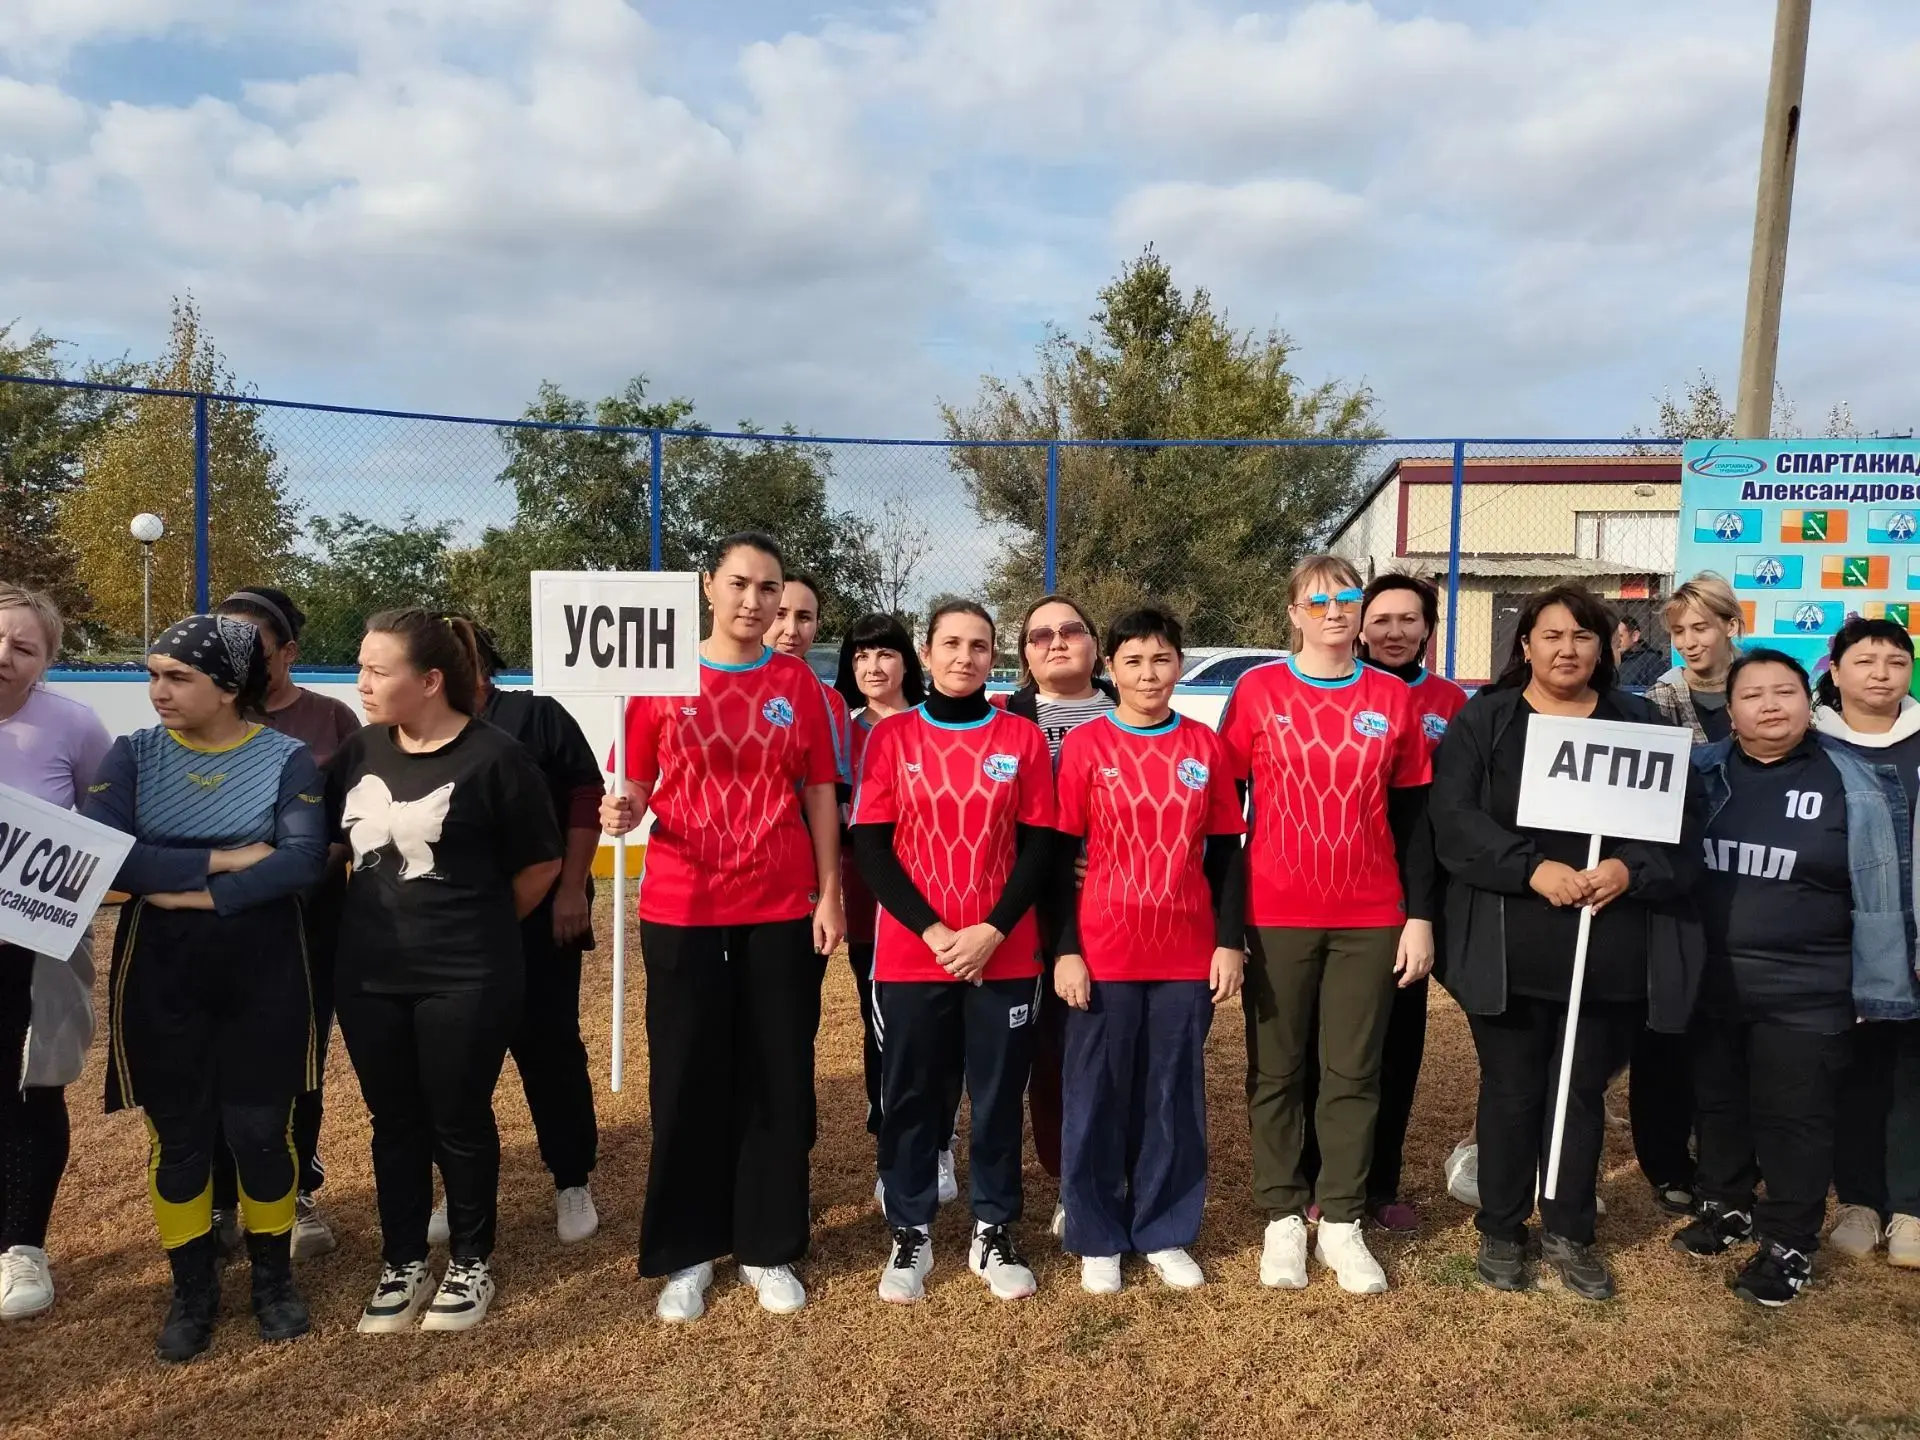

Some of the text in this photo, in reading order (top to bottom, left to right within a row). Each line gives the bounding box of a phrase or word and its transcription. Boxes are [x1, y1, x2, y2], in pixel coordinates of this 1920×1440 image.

[1777, 453, 1920, 476] СПАРТАКИА
[564, 604, 675, 669] УСПН
[1548, 741, 1674, 792] АГПЛ
[1785, 790, 1823, 820] 10
[0, 822, 101, 903] У СОШ
